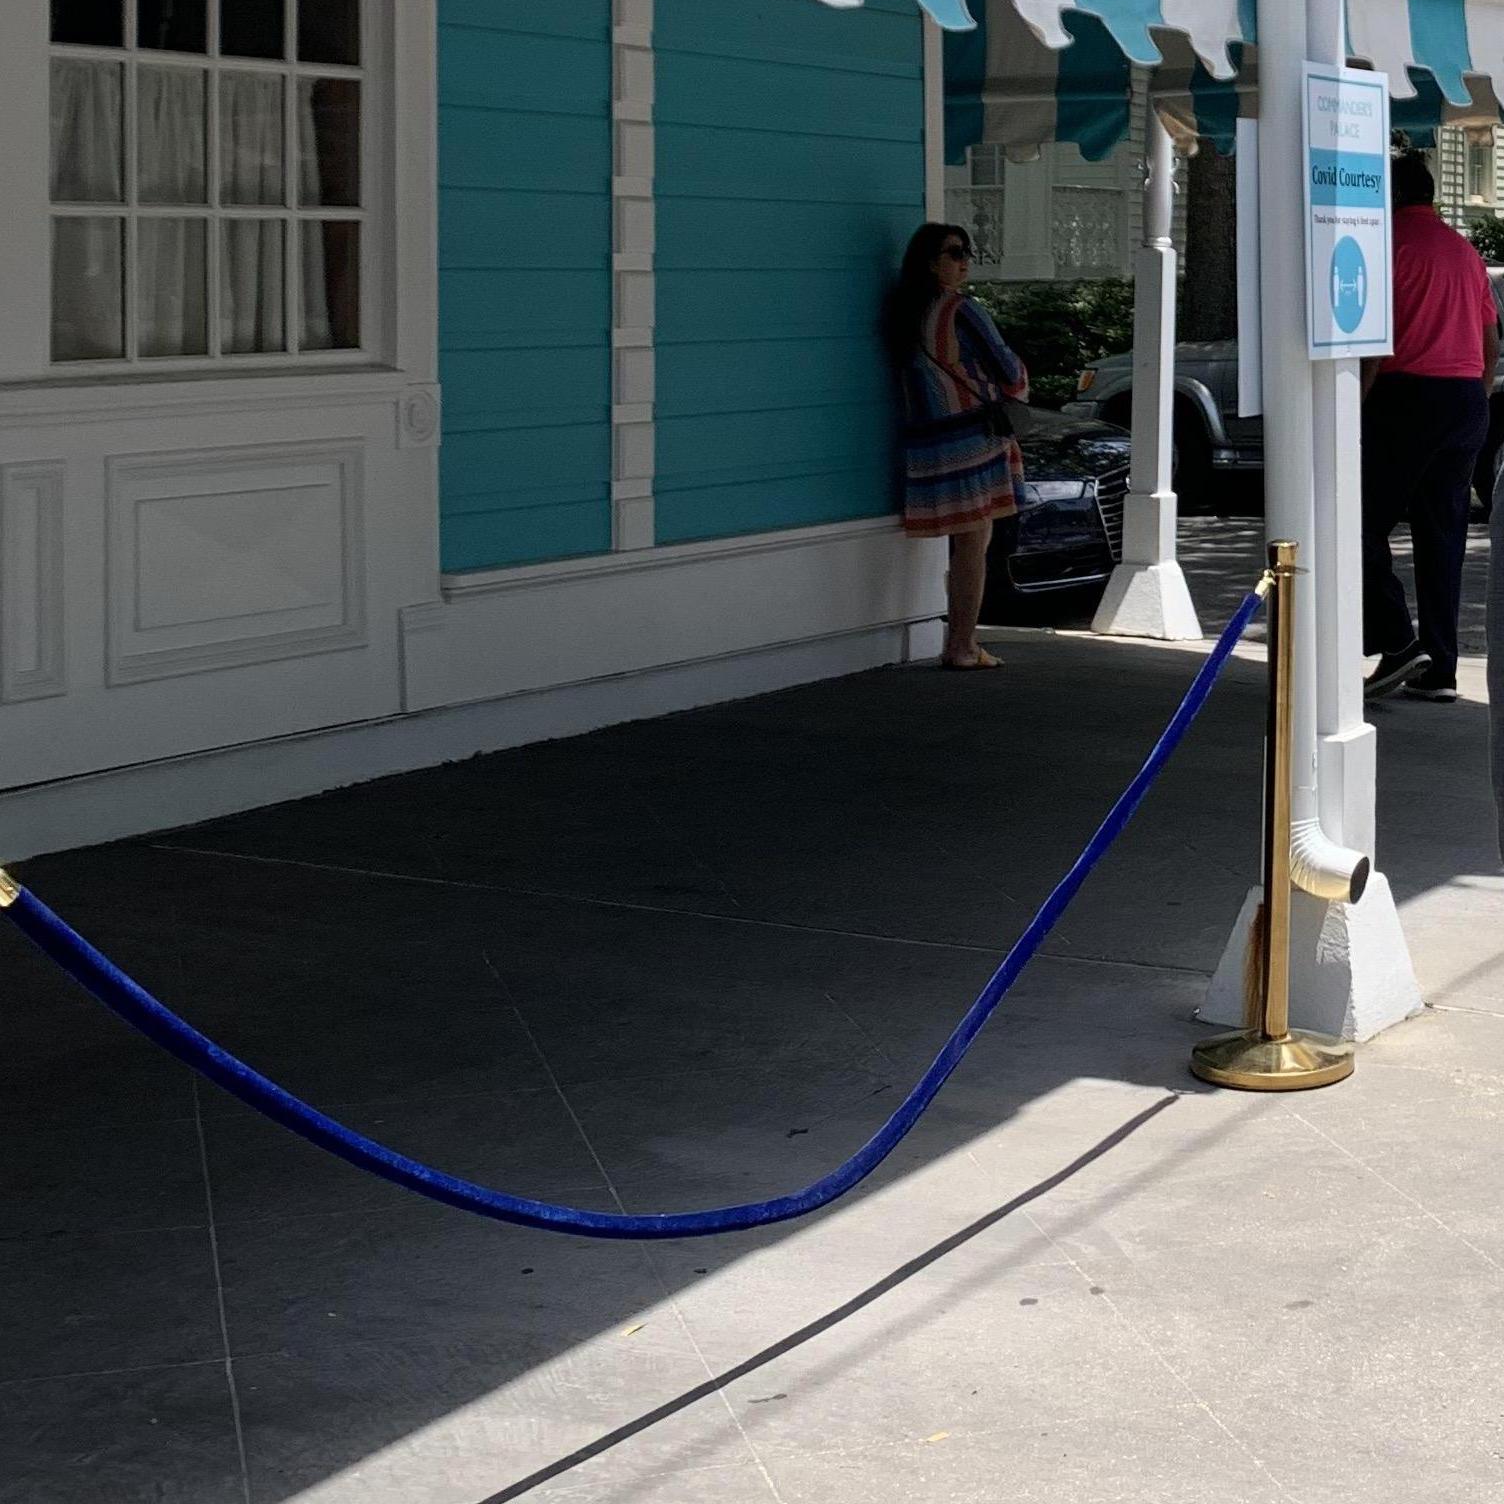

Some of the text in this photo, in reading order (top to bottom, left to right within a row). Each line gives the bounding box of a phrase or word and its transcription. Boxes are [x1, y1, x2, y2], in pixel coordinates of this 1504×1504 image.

[1330, 120, 1360, 138] PALACE
[1312, 165, 1382, 193] Covid Courtesy
